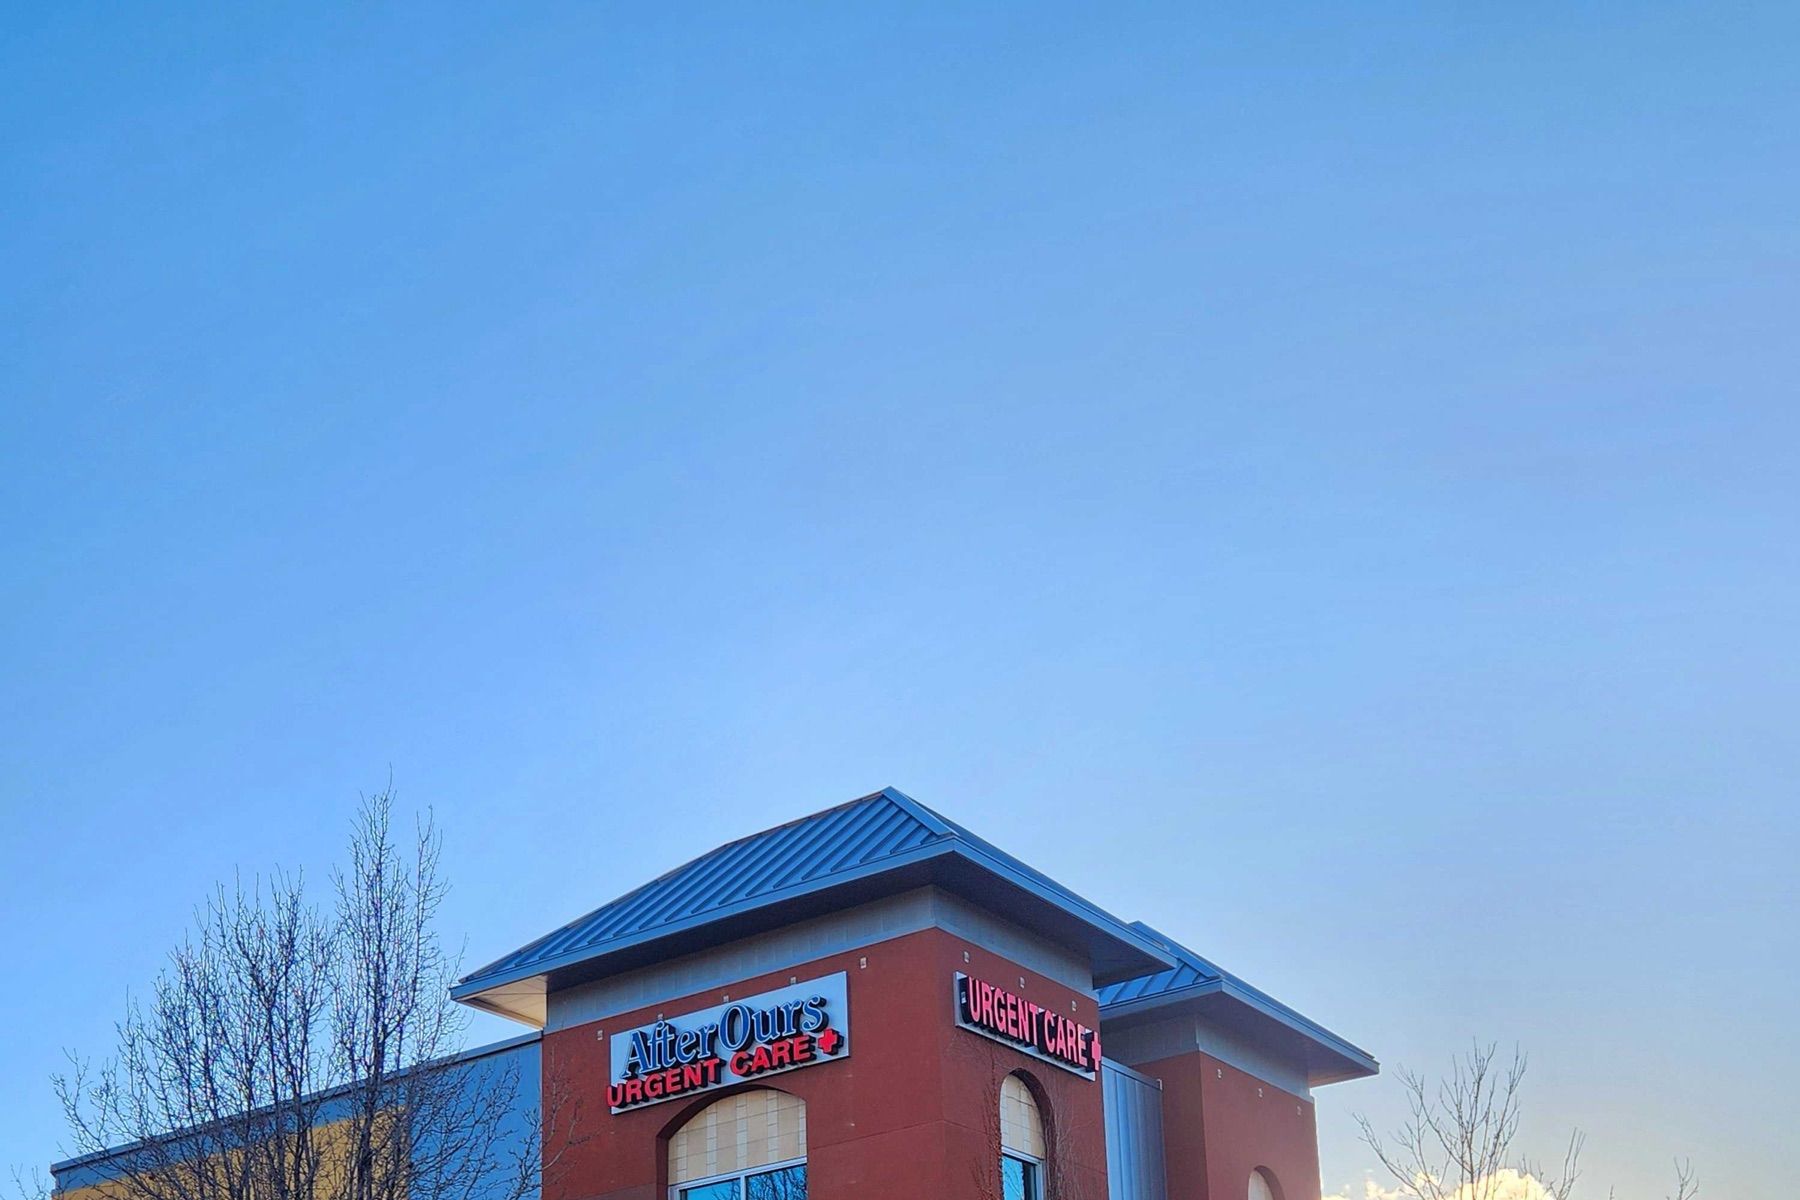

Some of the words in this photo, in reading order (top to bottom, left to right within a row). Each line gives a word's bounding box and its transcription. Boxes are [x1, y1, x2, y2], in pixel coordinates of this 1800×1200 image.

[968, 976, 1038, 1046] URGENT
[1044, 1010, 1088, 1067] CARE
[607, 1058, 720, 1107] URGENT
[729, 1034, 812, 1077] CARE
